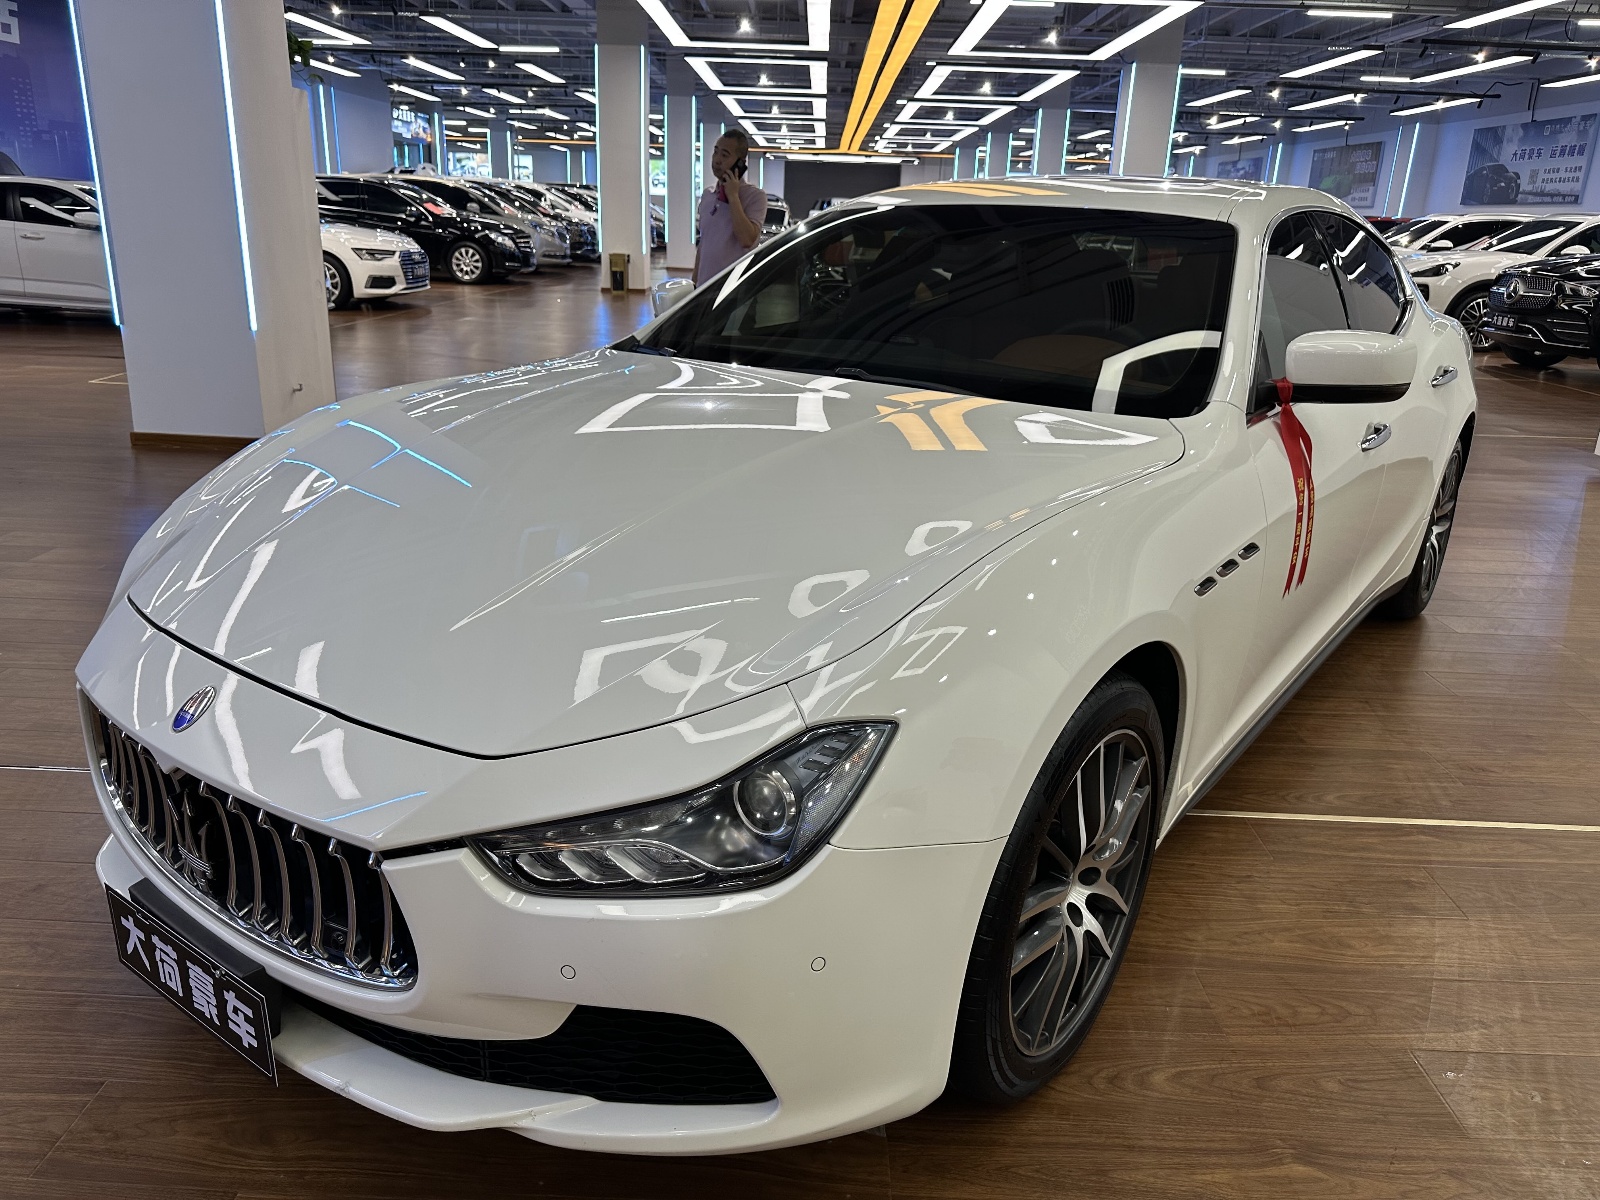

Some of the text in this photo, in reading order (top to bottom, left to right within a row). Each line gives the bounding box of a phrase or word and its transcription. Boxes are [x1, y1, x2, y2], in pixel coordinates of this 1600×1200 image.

[1511, 148, 1543, 162] 大荷豪车
[120, 914, 258, 1049] 大荷豪车
